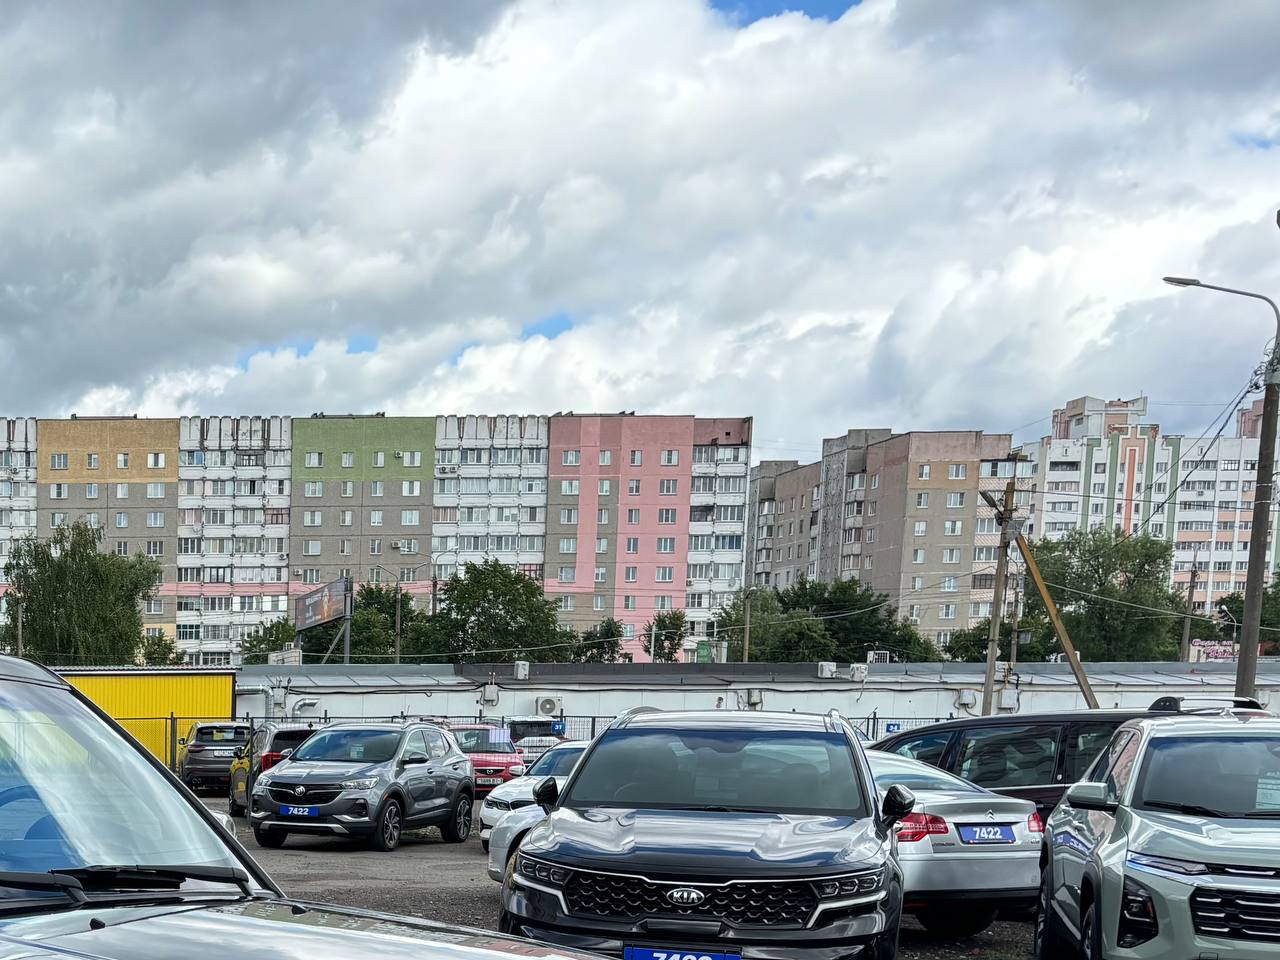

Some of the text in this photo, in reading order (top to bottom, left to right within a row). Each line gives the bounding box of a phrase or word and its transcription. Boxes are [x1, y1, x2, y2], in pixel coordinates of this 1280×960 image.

[288, 807, 309, 815] 7422
[973, 827, 1002, 839] 7422
[672, 891, 699, 903] KIA
